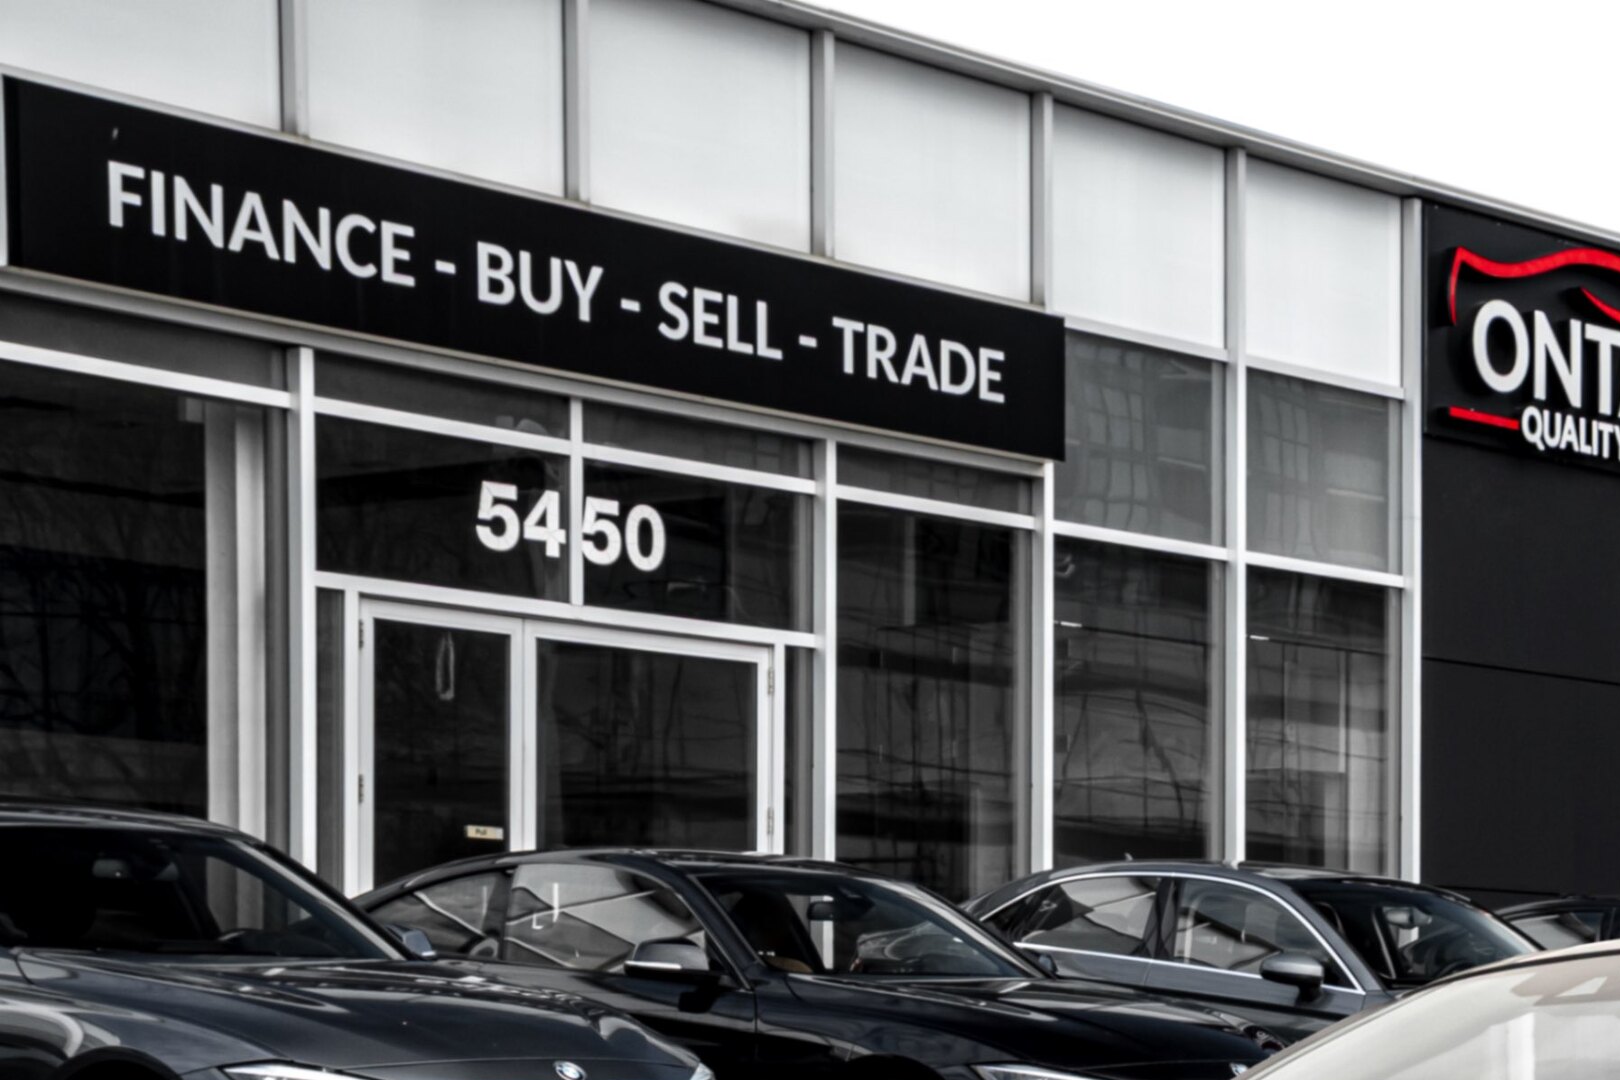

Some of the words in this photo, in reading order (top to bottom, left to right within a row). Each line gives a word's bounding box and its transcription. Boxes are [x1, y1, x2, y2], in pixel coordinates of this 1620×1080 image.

[108, 161, 416, 287] FINANCE
[477, 242, 603, 322] BUY
[658, 282, 783, 360] SELL
[832, 317, 1005, 403] TRADE
[475, 482, 666, 572] 5450
